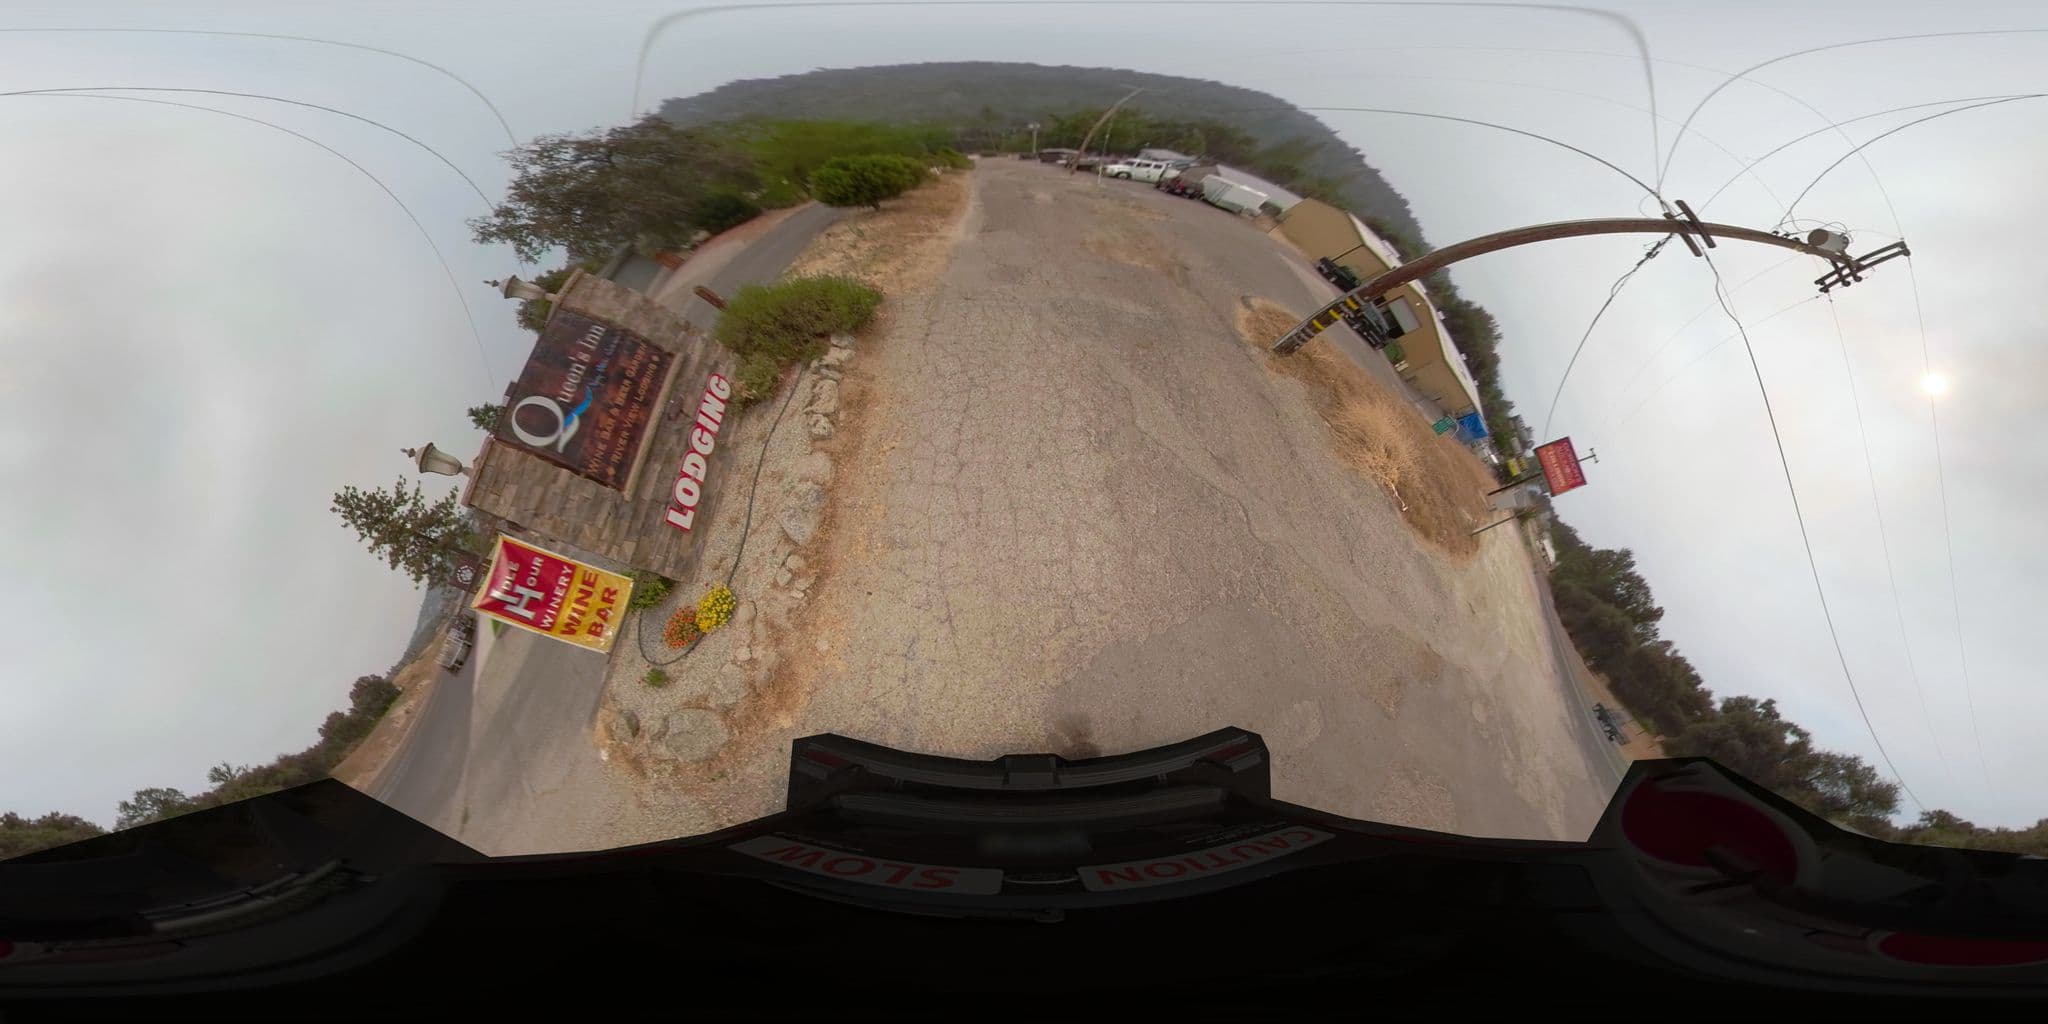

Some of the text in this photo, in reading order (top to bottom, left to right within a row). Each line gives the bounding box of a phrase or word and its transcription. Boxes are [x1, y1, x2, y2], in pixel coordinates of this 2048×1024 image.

[512, 351, 591, 453] Queen's
[577, 325, 607, 351] Inn
[624, 401, 640, 429] VIEW
[638, 362, 658, 402] LODGING
[587, 446, 605, 473] WINE
[665, 374, 731, 532] LODGING
[490, 561, 520, 604] IDLE
[504, 556, 544, 620] HOUR
[540, 565, 573, 628] WINERY
[560, 570, 600, 636] WINE
[587, 586, 619, 638] BAR
[760, 845, 960, 889] SLOW
[1095, 831, 1314, 885] CAUTION
